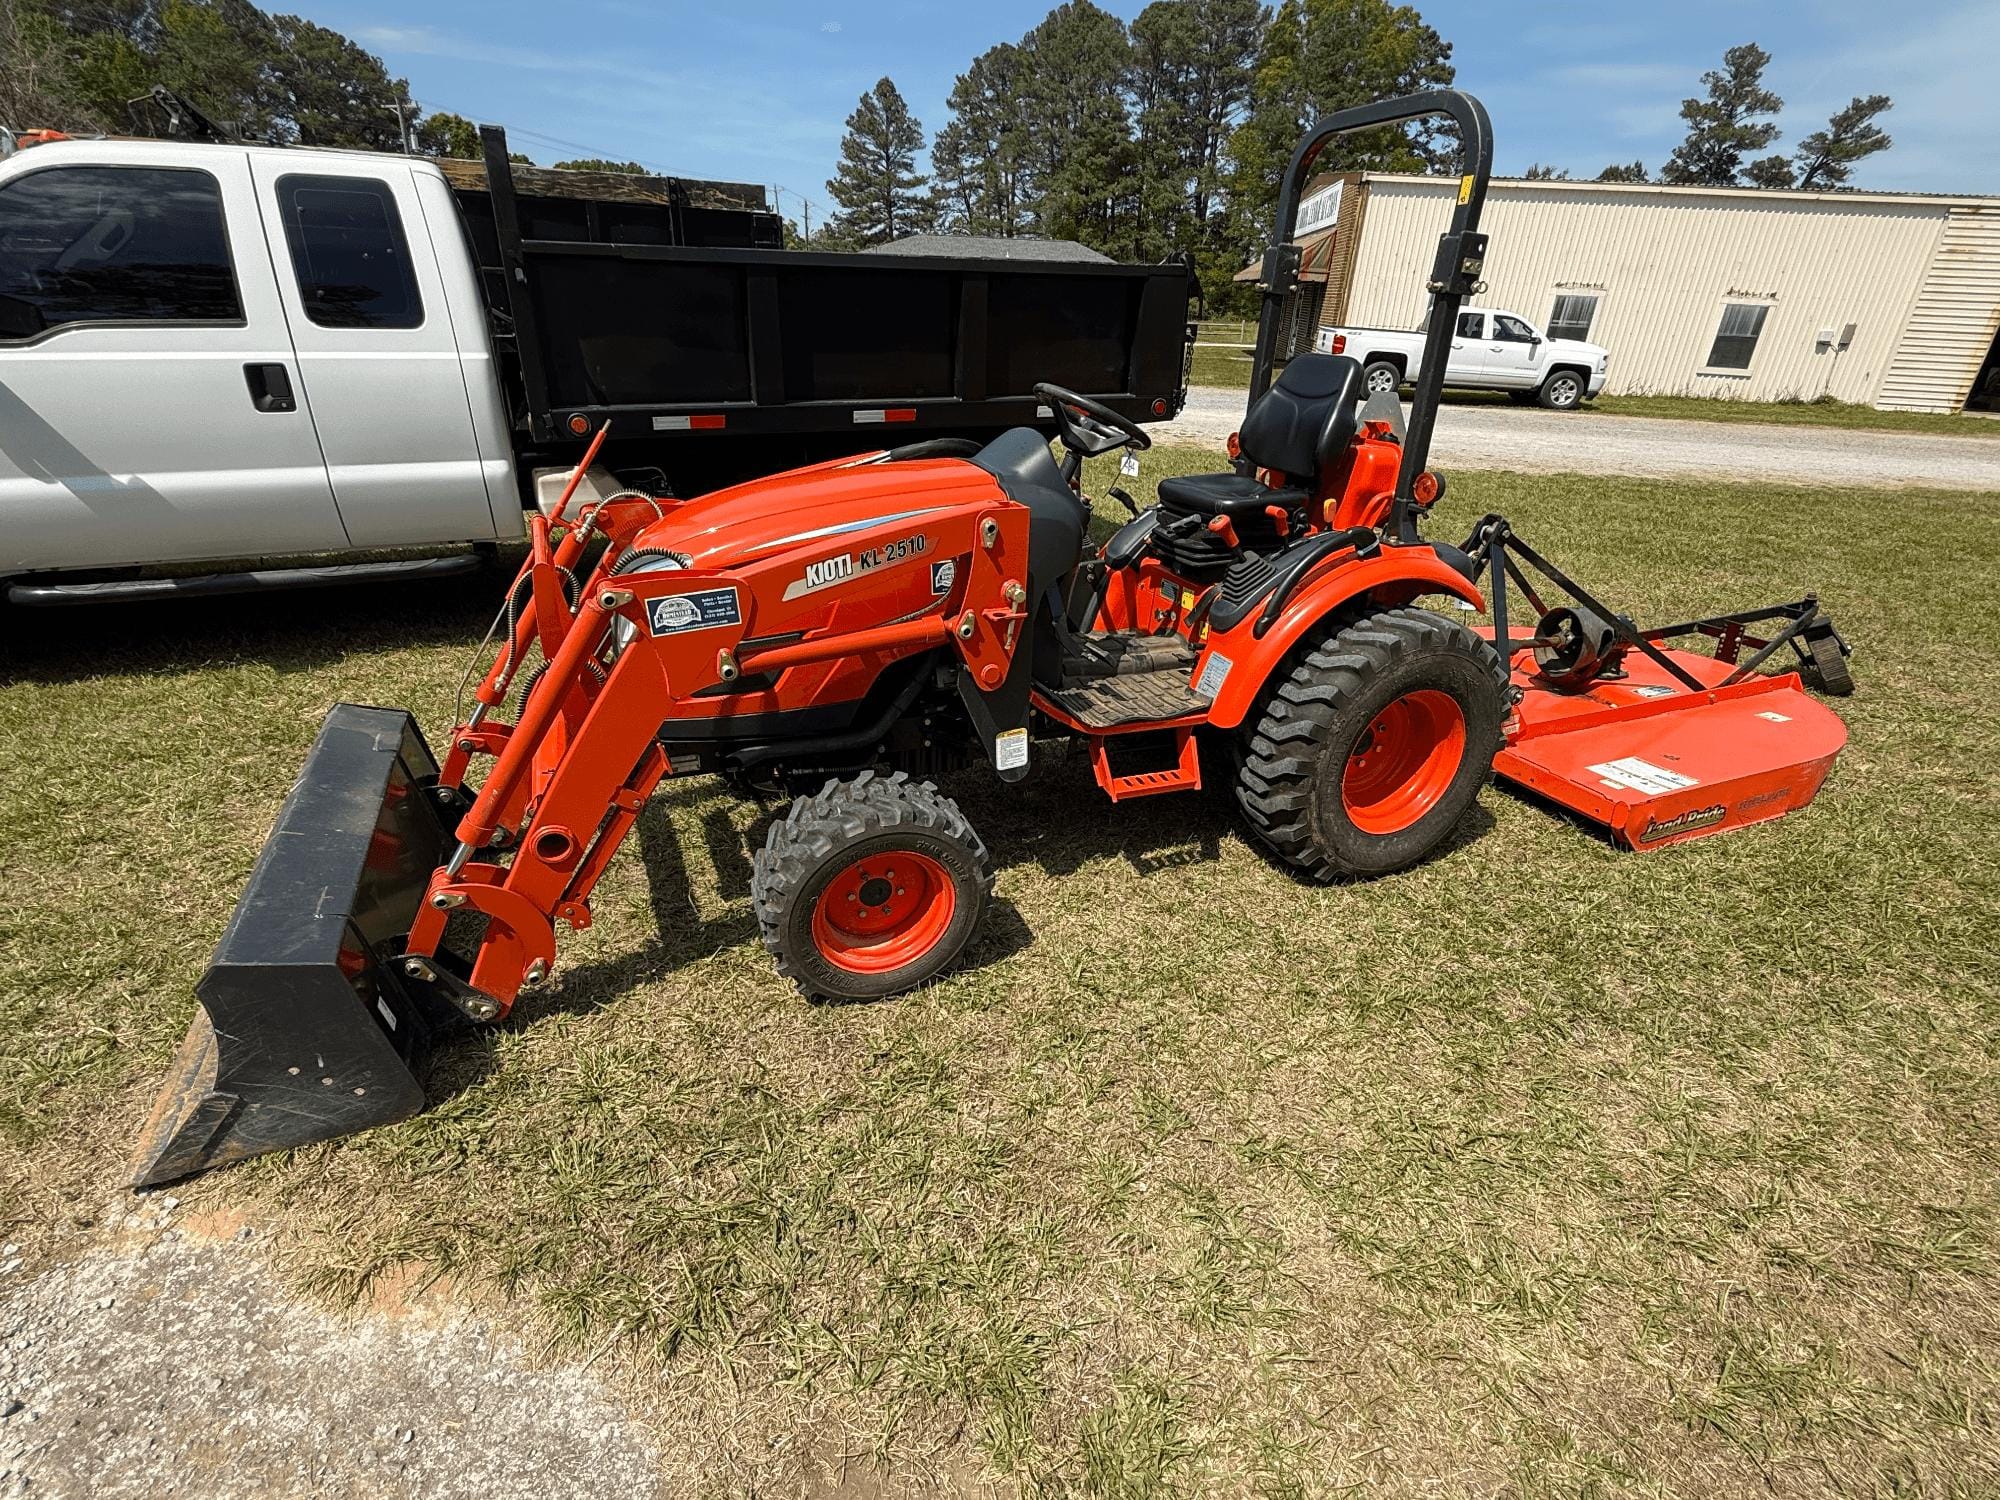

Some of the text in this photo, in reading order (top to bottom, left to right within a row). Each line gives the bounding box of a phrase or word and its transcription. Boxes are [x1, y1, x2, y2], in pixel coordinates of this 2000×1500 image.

[805, 533, 925, 588] KIOTI KL 2510
[1645, 804, 1726, 834] Land Pride
